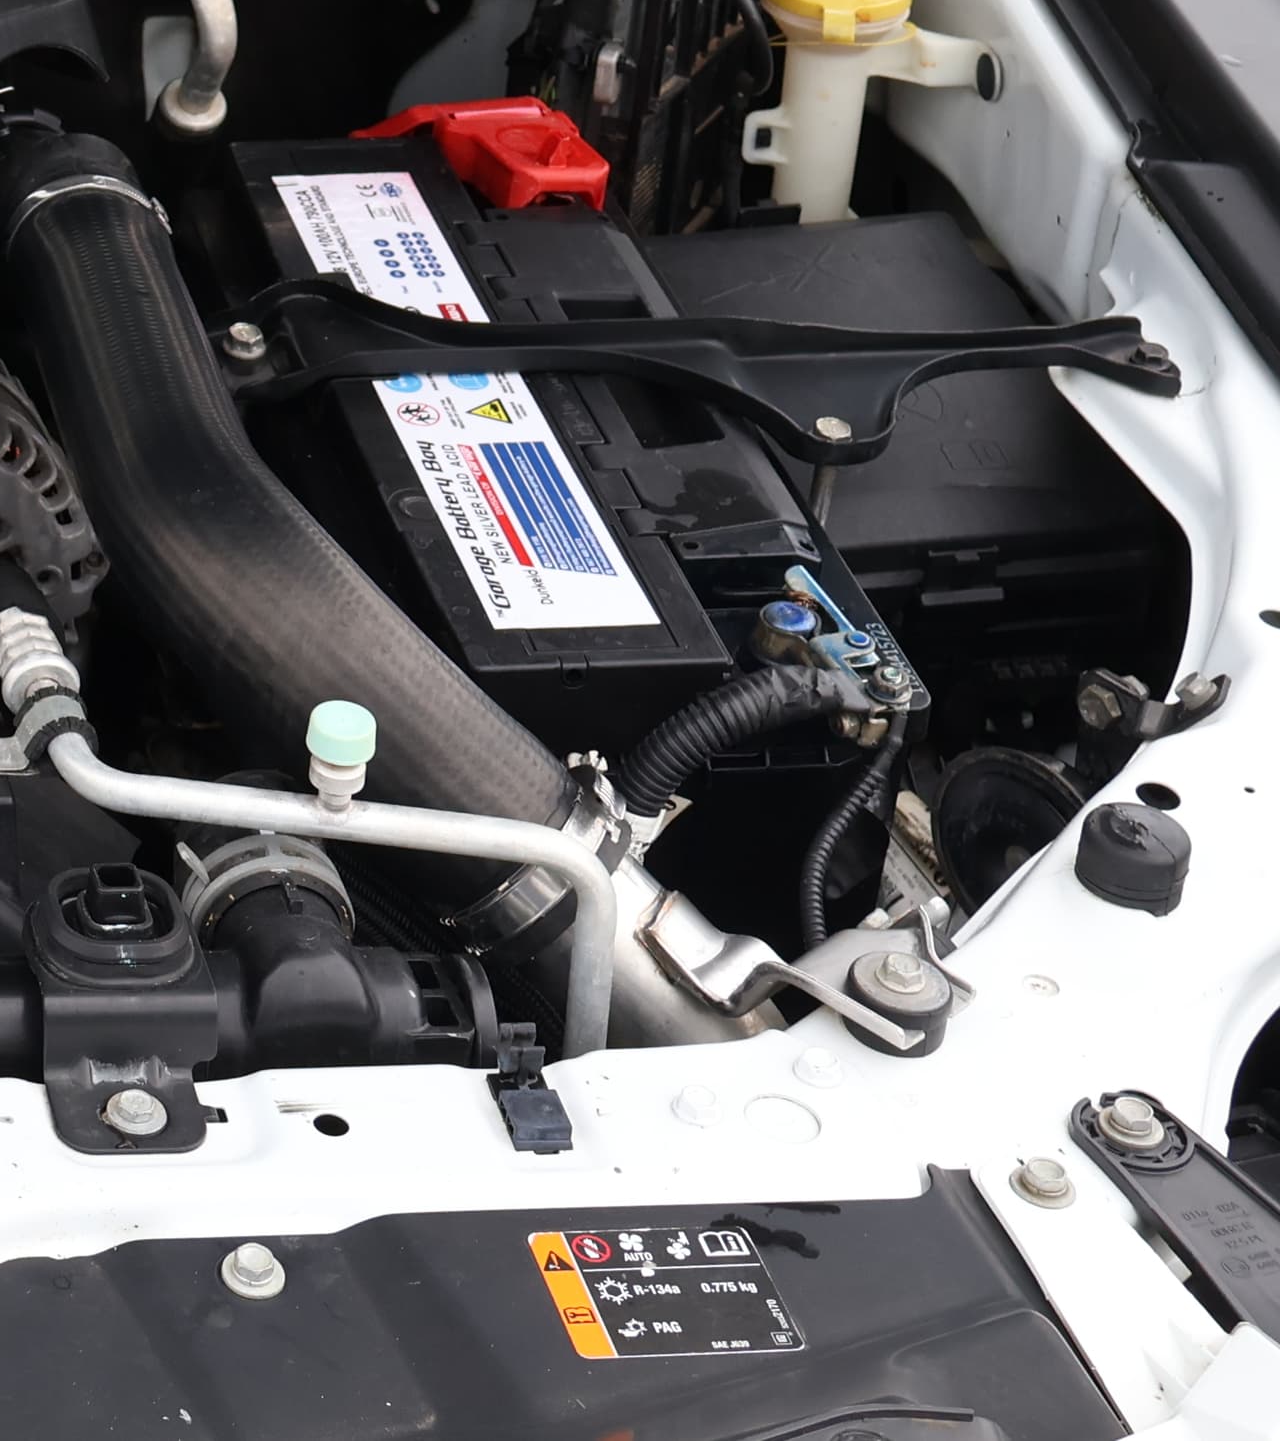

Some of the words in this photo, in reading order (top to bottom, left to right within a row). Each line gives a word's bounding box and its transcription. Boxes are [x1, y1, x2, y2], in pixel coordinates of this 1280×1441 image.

[416, 441, 443, 472] Bay
[442, 445, 460, 466] ACID
[456, 474, 479, 498] LEAD
[435, 478, 477, 540] Battery
[471, 503, 499, 537] SILVER
[492, 542, 511, 563] NEW
[470, 546, 511, 609] Garage
[528, 570, 553, 604] Dunkeld
[624, 1252, 653, 1262] AUTO
[633, 1284, 681, 1295] R-134a
[700, 1282, 737, 1293] 0.775
[740, 1281, 758, 1294] kg
[653, 1321, 682, 1333] PAG
